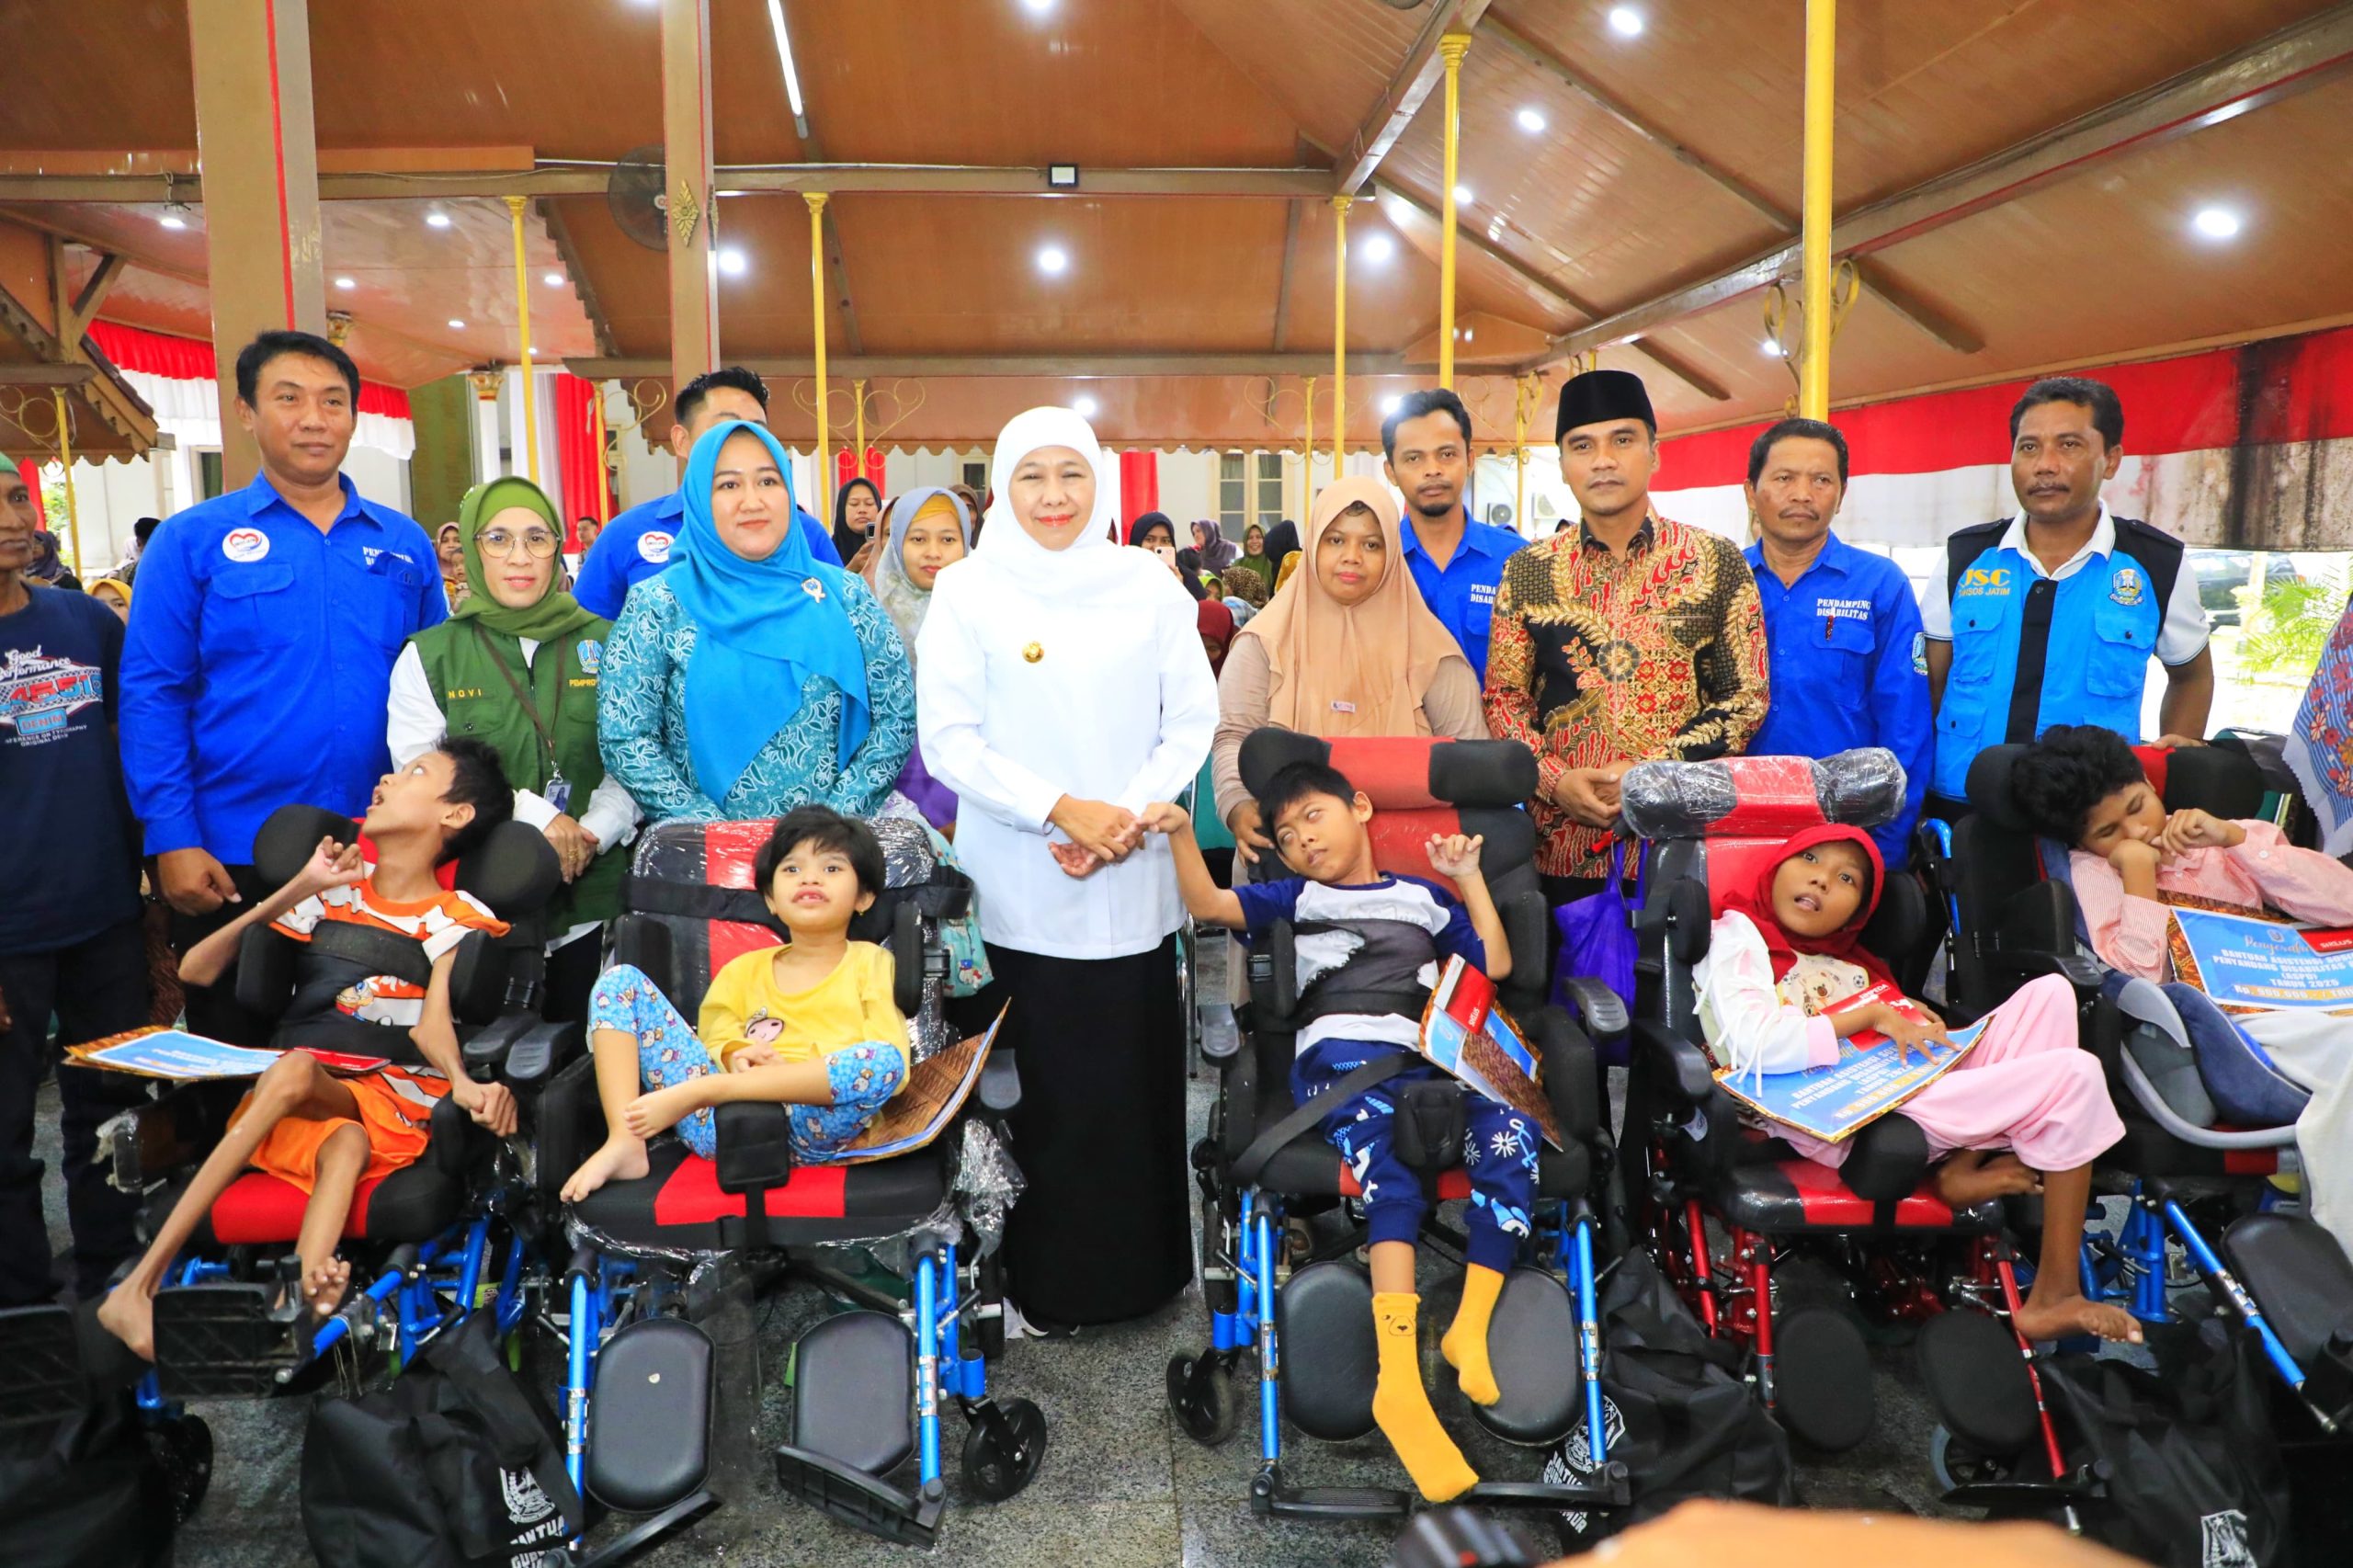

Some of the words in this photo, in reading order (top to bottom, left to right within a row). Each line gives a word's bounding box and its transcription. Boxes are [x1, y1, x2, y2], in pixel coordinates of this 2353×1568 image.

[1959, 568, 2011, 588] JSC
[1471, 584, 1496, 596] PENDA
[1985, 587, 2010, 597] JATIM
[1470, 593, 1494, 605] DISAB
[1816, 597, 1871, 611] PENDAMPING
[5, 643, 42, 666] Good
[568, 678, 597, 687] PEMPRO
[448, 688, 483, 699] NOVI
[2221, 949, 2268, 963] BANTUAN
[2212, 955, 2279, 971] PENYANDANG
[2279, 961, 2347, 973] DISABILITAS
[2268, 978, 2307, 988] TAHUN
[1849, 1055, 1900, 1081] DISABILITA
[1791, 1076, 1836, 1099] BANTUAN
[1560, 1511, 1587, 1534] MUR
[510, 1516, 564, 1545] ANTUA
